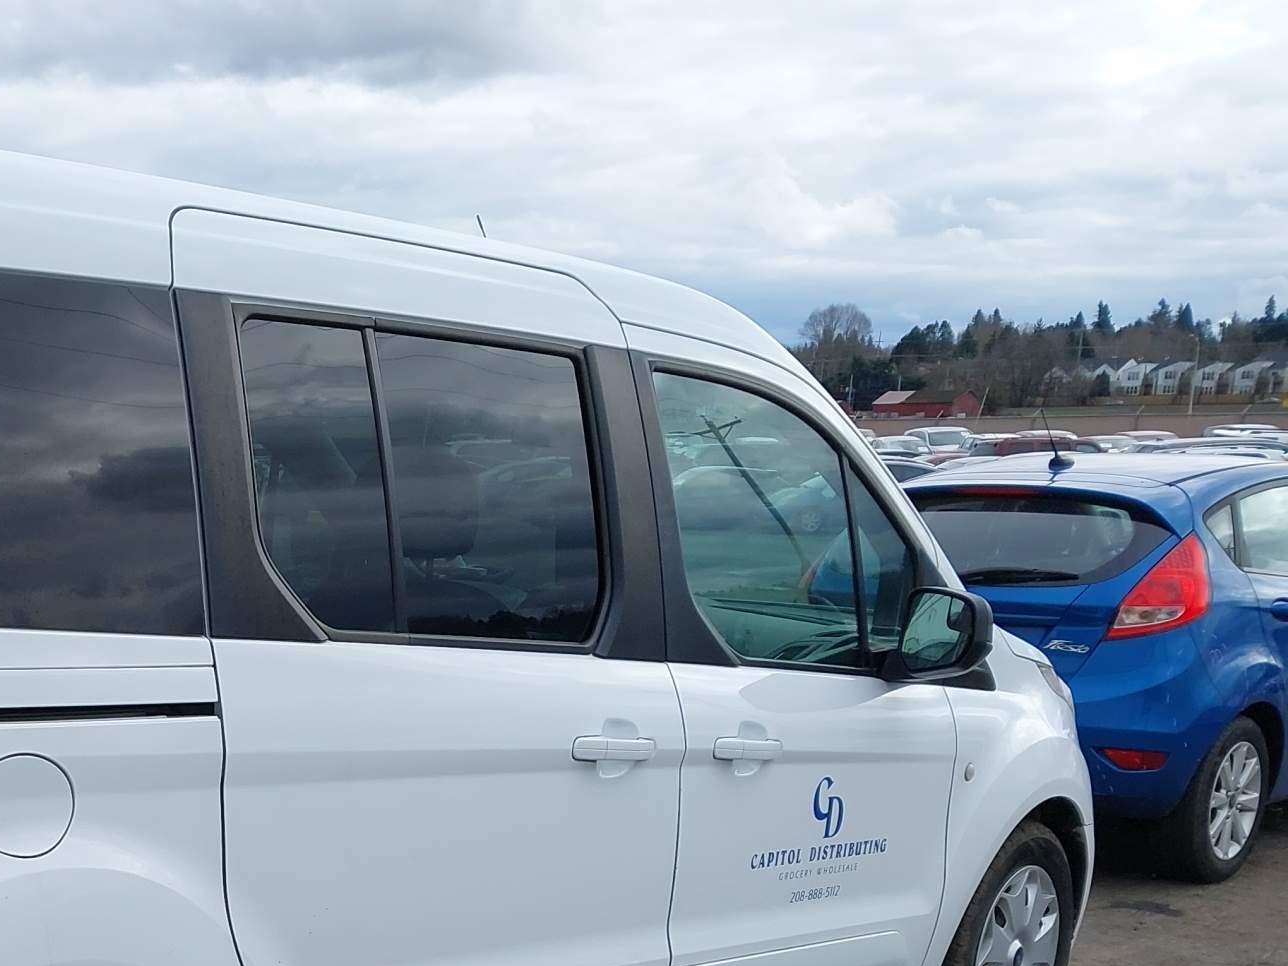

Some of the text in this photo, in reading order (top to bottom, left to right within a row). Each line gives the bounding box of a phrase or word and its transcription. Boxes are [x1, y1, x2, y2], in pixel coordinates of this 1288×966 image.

[1042, 639, 1090, 653] Fiesta
[750, 838, 887, 869] CAPITOL DISTRIBUTING
[779, 862, 859, 881] GROCERY WHOLESALE
